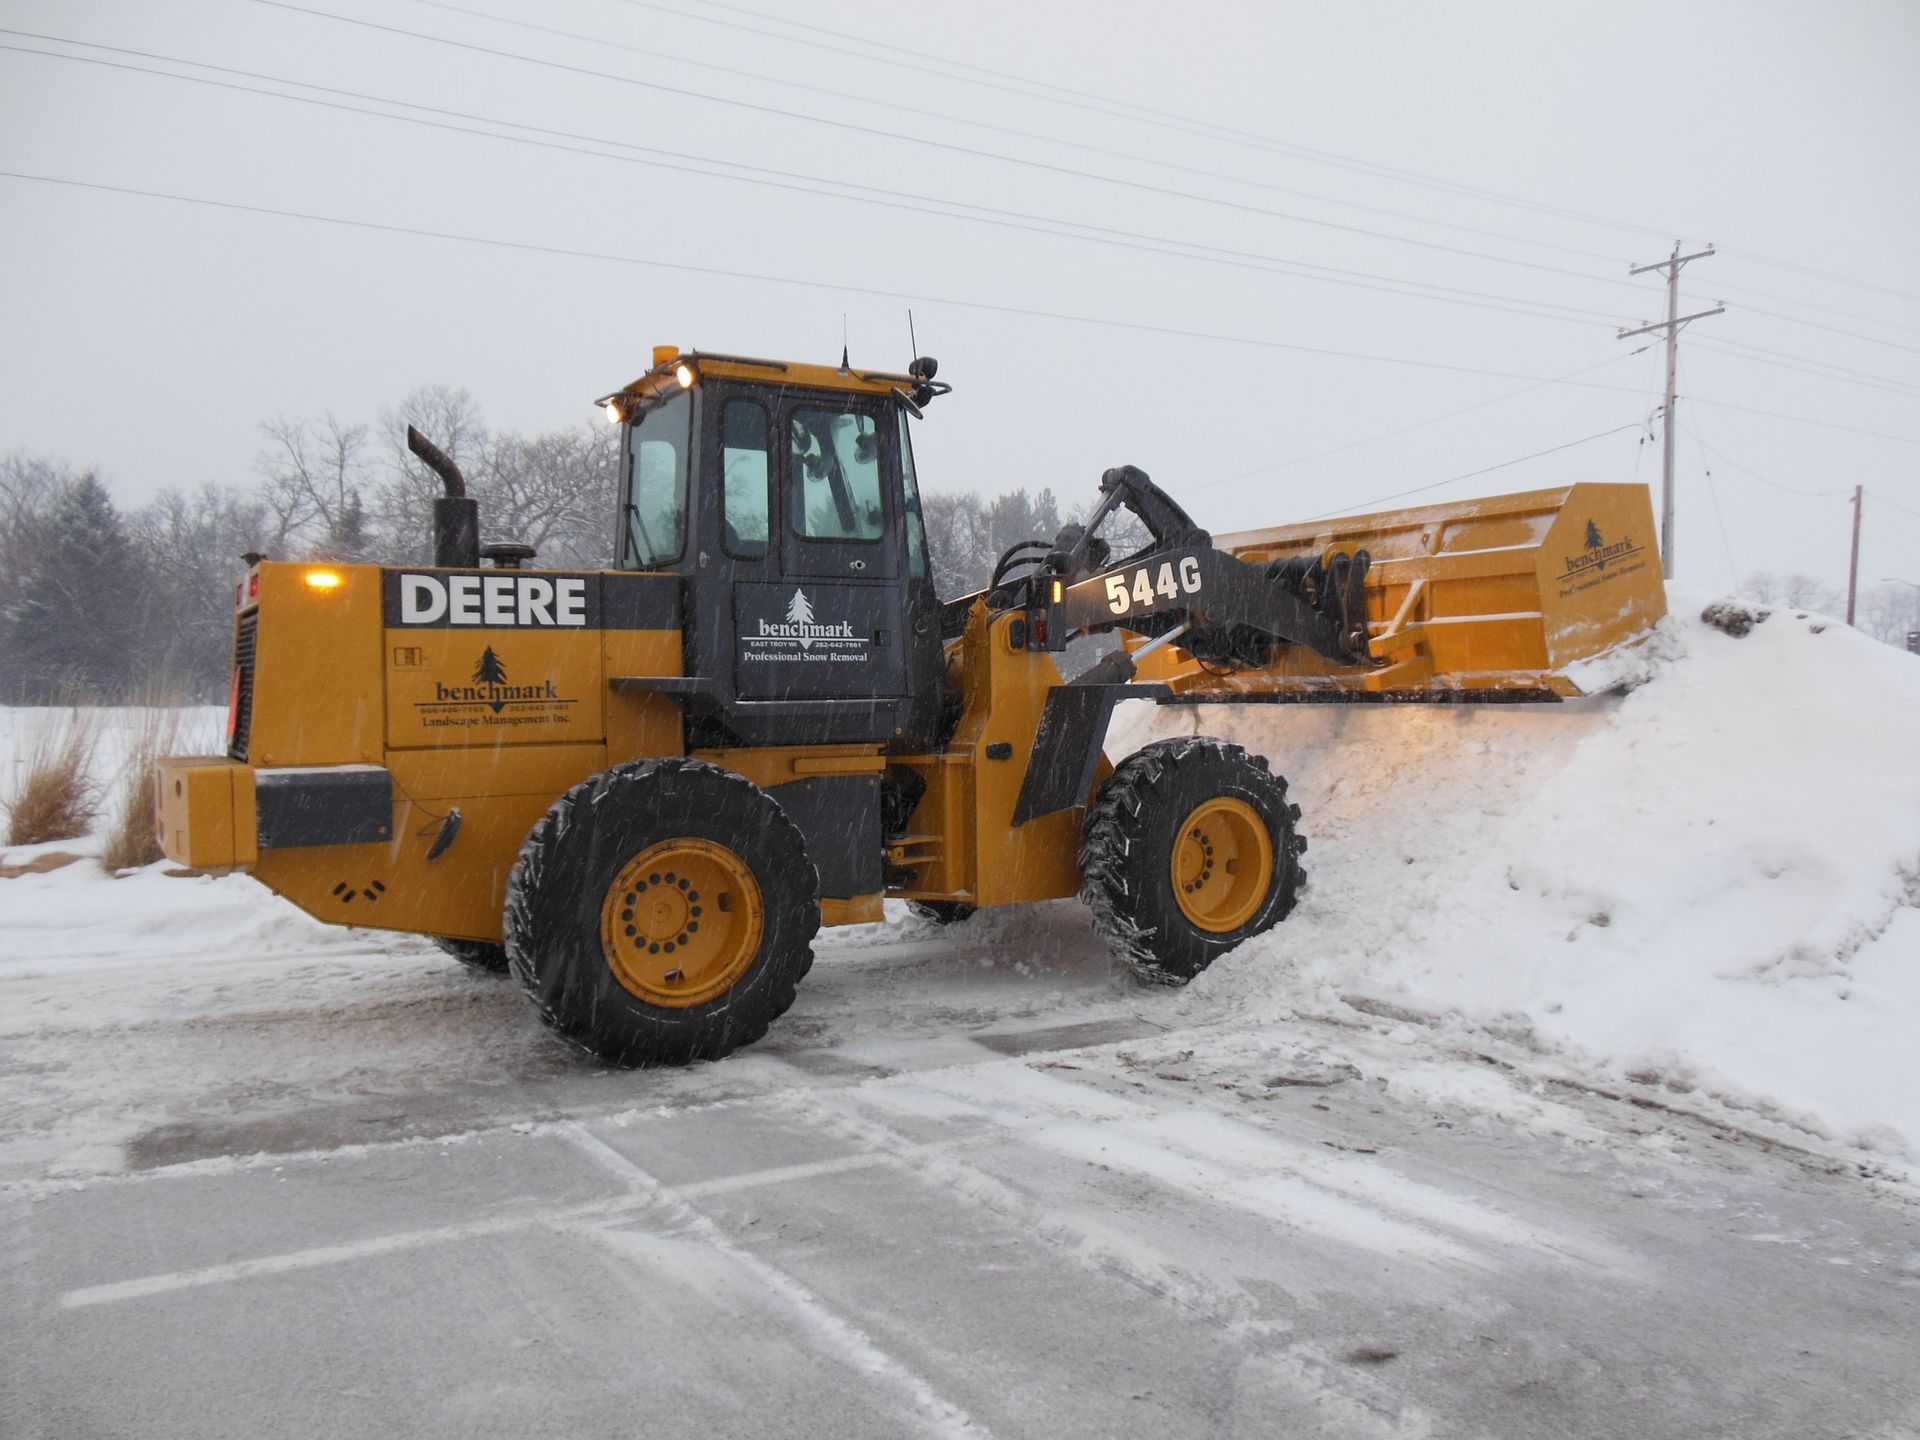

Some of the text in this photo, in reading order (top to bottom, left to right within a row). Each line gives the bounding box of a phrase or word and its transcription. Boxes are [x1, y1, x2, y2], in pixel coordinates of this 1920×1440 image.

[1565, 536, 1633, 571] benchmark
[1105, 556, 1202, 615] 544G
[400, 573, 586, 626] DEERE
[758, 618, 854, 638] benchmark
[744, 651, 868, 662] Professional Snow Removal
[436, 680, 558, 701] benchmark
[423, 712, 572, 729] Landscape Management Inc.
